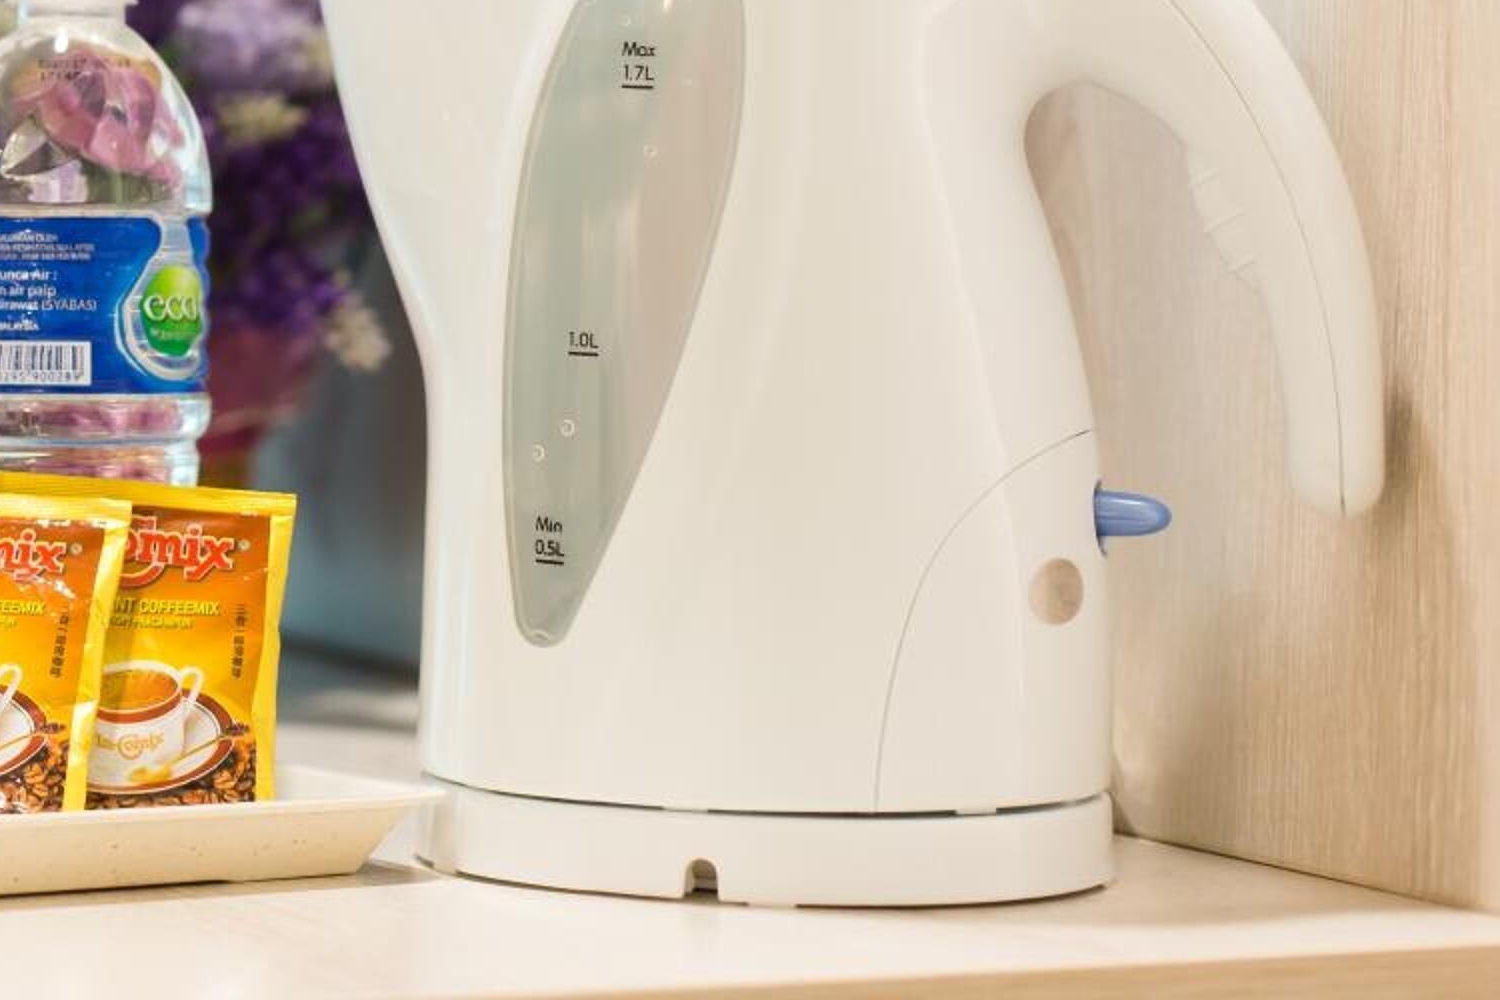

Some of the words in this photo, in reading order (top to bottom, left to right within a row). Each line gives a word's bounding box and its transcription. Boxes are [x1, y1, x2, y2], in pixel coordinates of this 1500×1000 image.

[621, 41, 656, 57] Max
[624, 64, 655, 81] 1.7L
[27, 284, 57, 299] paip
[41, 300, 97, 312] (SYABAS)
[569, 331, 599, 349] 1.0L
[535, 516, 563, 534] Min
[535, 539, 565, 557] 0.5L
[139, 598, 221, 616] COFFEEMIX
